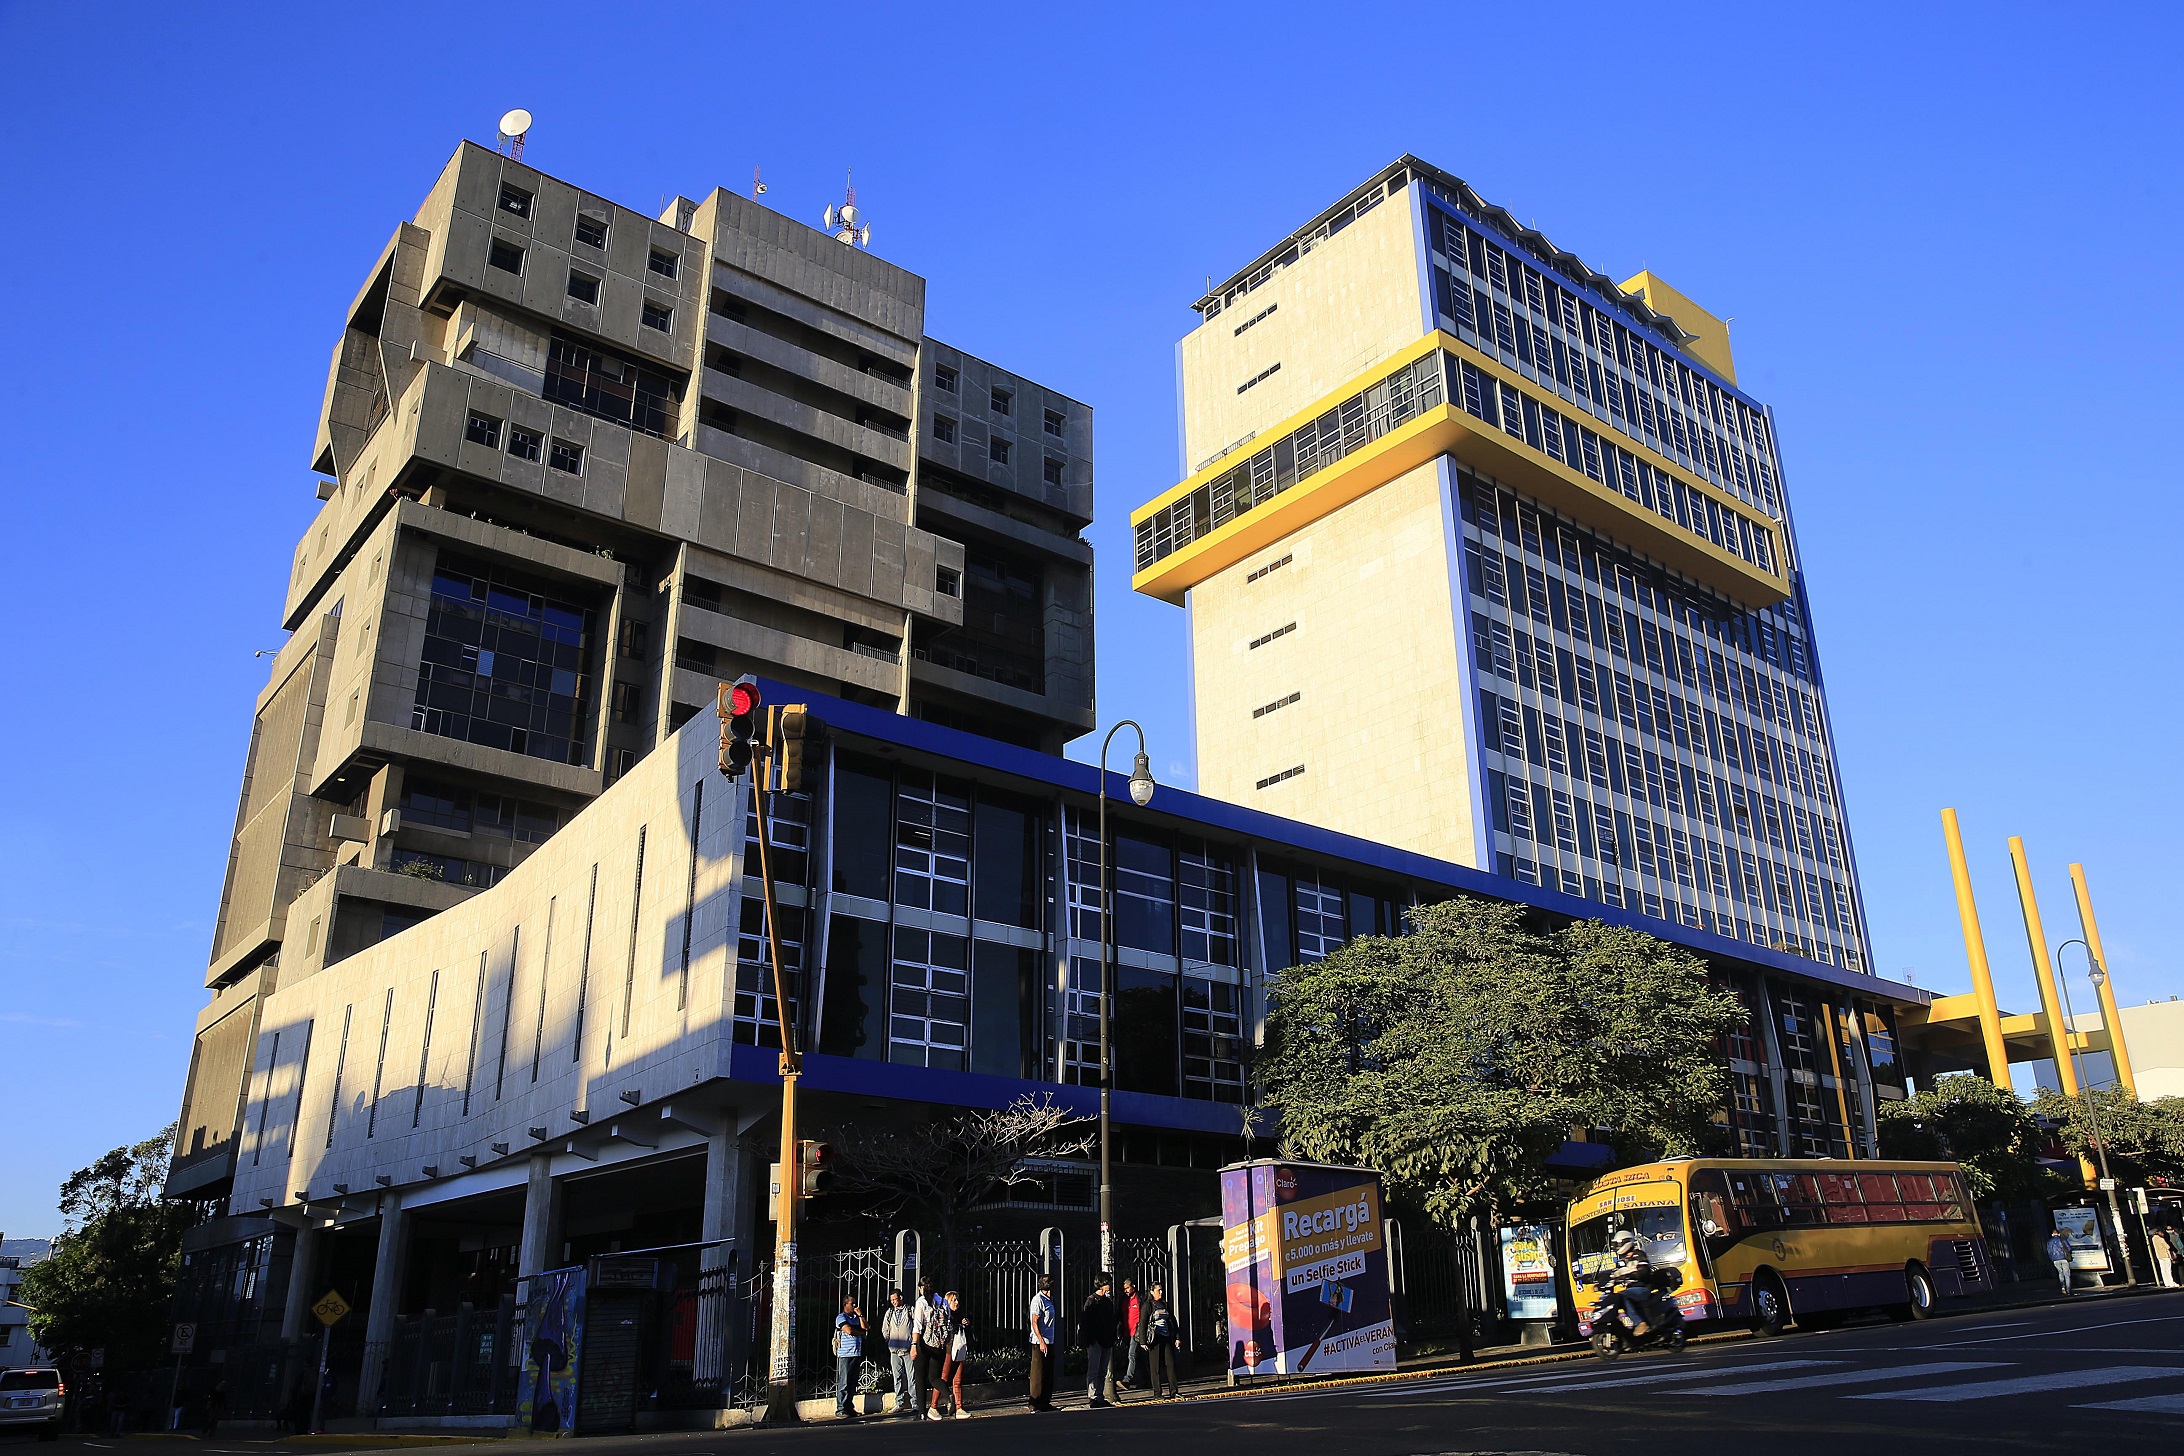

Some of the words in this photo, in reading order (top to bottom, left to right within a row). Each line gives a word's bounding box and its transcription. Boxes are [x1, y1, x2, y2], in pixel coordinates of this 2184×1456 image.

[1275, 1177, 1295, 1188] Claro
[1624, 1172, 1650, 1182] RICA
[1599, 1200, 1612, 1208] SAN
[1616, 1195, 1636, 1203] JOSE
[1623, 1199, 1675, 1209] SABANA
[1283, 1192, 1370, 1241] Recargá
[1571, 1207, 1608, 1225] CEMENTERIO
[1249, 1220, 1264, 1236] Kit
[1228, 1234, 1266, 1257] Prepago
[1315, 1245, 1320, 1254] o
[1321, 1238, 1339, 1253] más
[1340, 1238, 1346, 1250] y
[1346, 1231, 1374, 1247] llevate
[1291, 1273, 1305, 1286] un
[1306, 1264, 1336, 1282] Selfie
[1337, 1256, 1362, 1274] Stick
[1372, 1346, 1384, 1355] con
